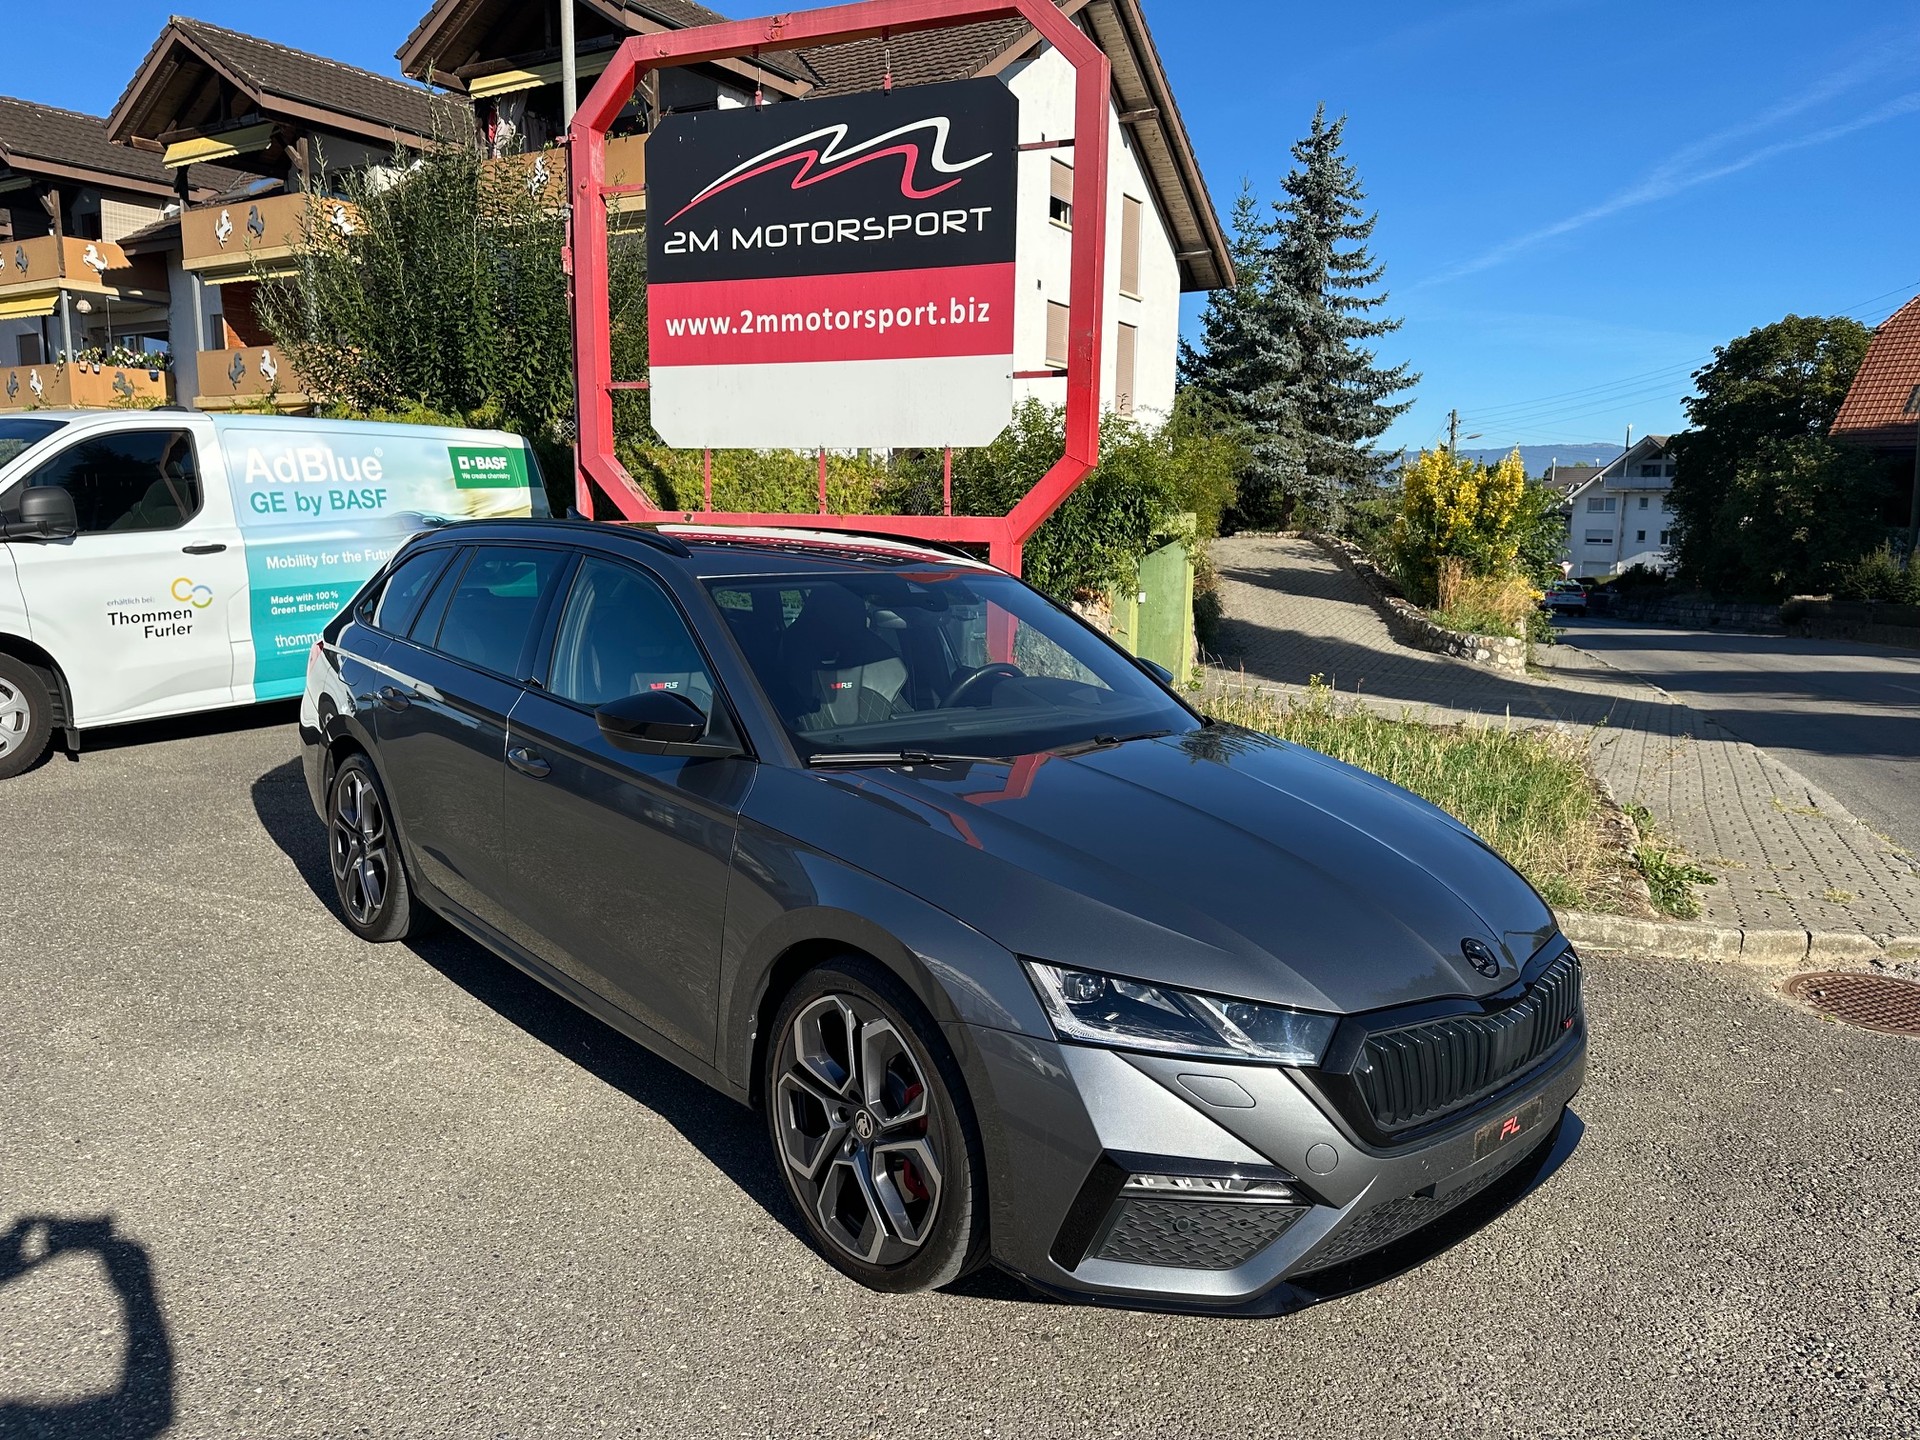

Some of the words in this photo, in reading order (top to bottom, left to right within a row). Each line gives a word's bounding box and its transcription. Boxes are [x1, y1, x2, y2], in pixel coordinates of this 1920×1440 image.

[663, 230, 719, 254] 2M
[732, 206, 993, 250] MOTORSPORT
[664, 296, 991, 337] www.2mmotorsport.biz
[475, 456, 508, 470] BASF
[487, 472, 510, 480] chemistry
[250, 491, 288, 514] GE
[294, 491, 323, 517] by
[328, 488, 388, 511] BASF
[266, 556, 318, 569] Mobility
[321, 553, 338, 565] for
[341, 551, 363, 564] the
[106, 598, 141, 607] erhältlich
[270, 596, 293, 604] Made
[295, 594, 313, 602] with
[315, 592, 330, 600] 100
[330, 590, 339, 599] %
[271, 606, 296, 615] Green
[299, 601, 339, 612] Electricity
[107, 609, 193, 626] Thommen
[144, 623, 193, 639] Furler
